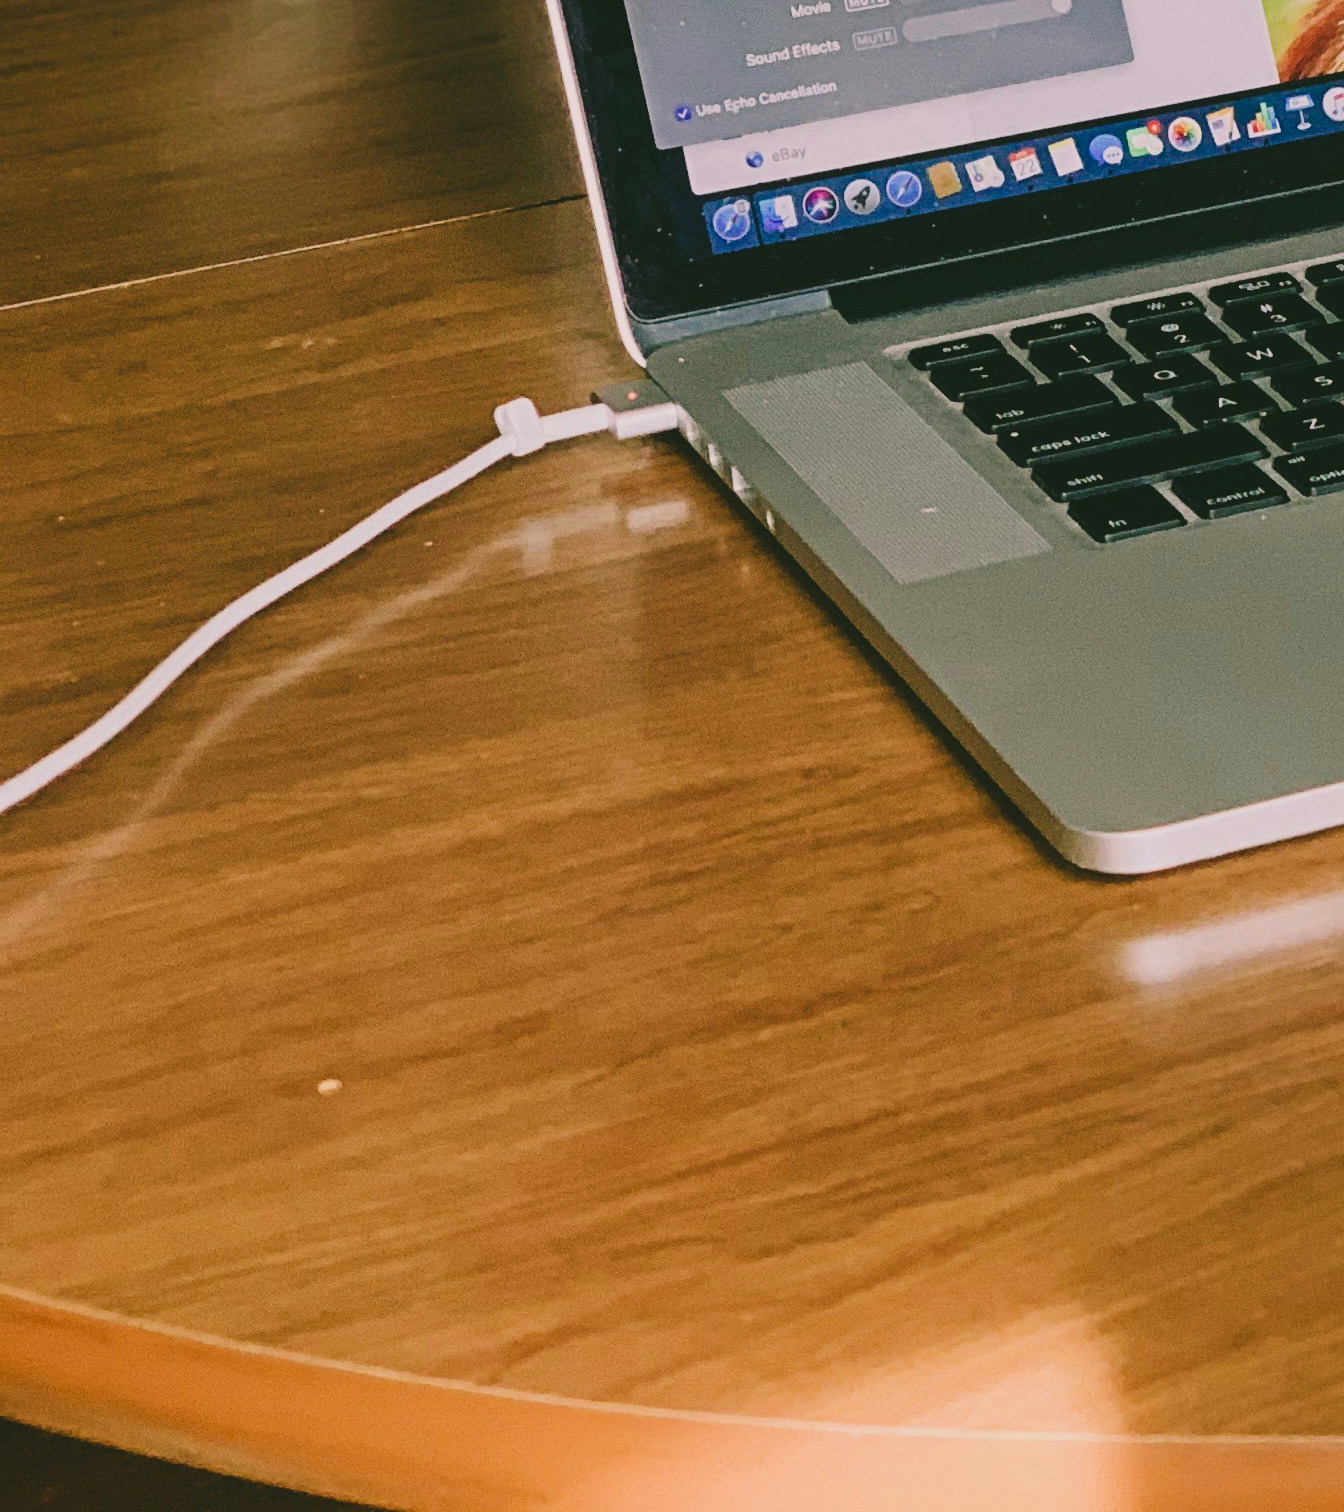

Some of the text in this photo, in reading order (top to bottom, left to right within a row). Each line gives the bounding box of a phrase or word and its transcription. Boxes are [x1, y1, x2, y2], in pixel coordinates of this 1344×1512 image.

[790, 0, 832, 19] Movie
[857, 31, 893, 46] MUTE
[745, 39, 841, 68] Sound Effects
[695, 81, 838, 118] Use Echo Cancellation
[771, 146, 806, 163] eBay
[1016, 158, 1037, 176] 22
[1246, 347, 1274, 361] W
[1153, 369, 1178, 381] Q
[1314, 375, 1333, 387] S
[1218, 397, 1238, 408] A
[996, 408, 1024, 419] tab
[1302, 418, 1326, 431] Z
[1031, 431, 1110, 454] caps lock
[1066, 473, 1104, 487] shift
[1206, 487, 1266, 506] control
[1108, 518, 1127, 528] fn
